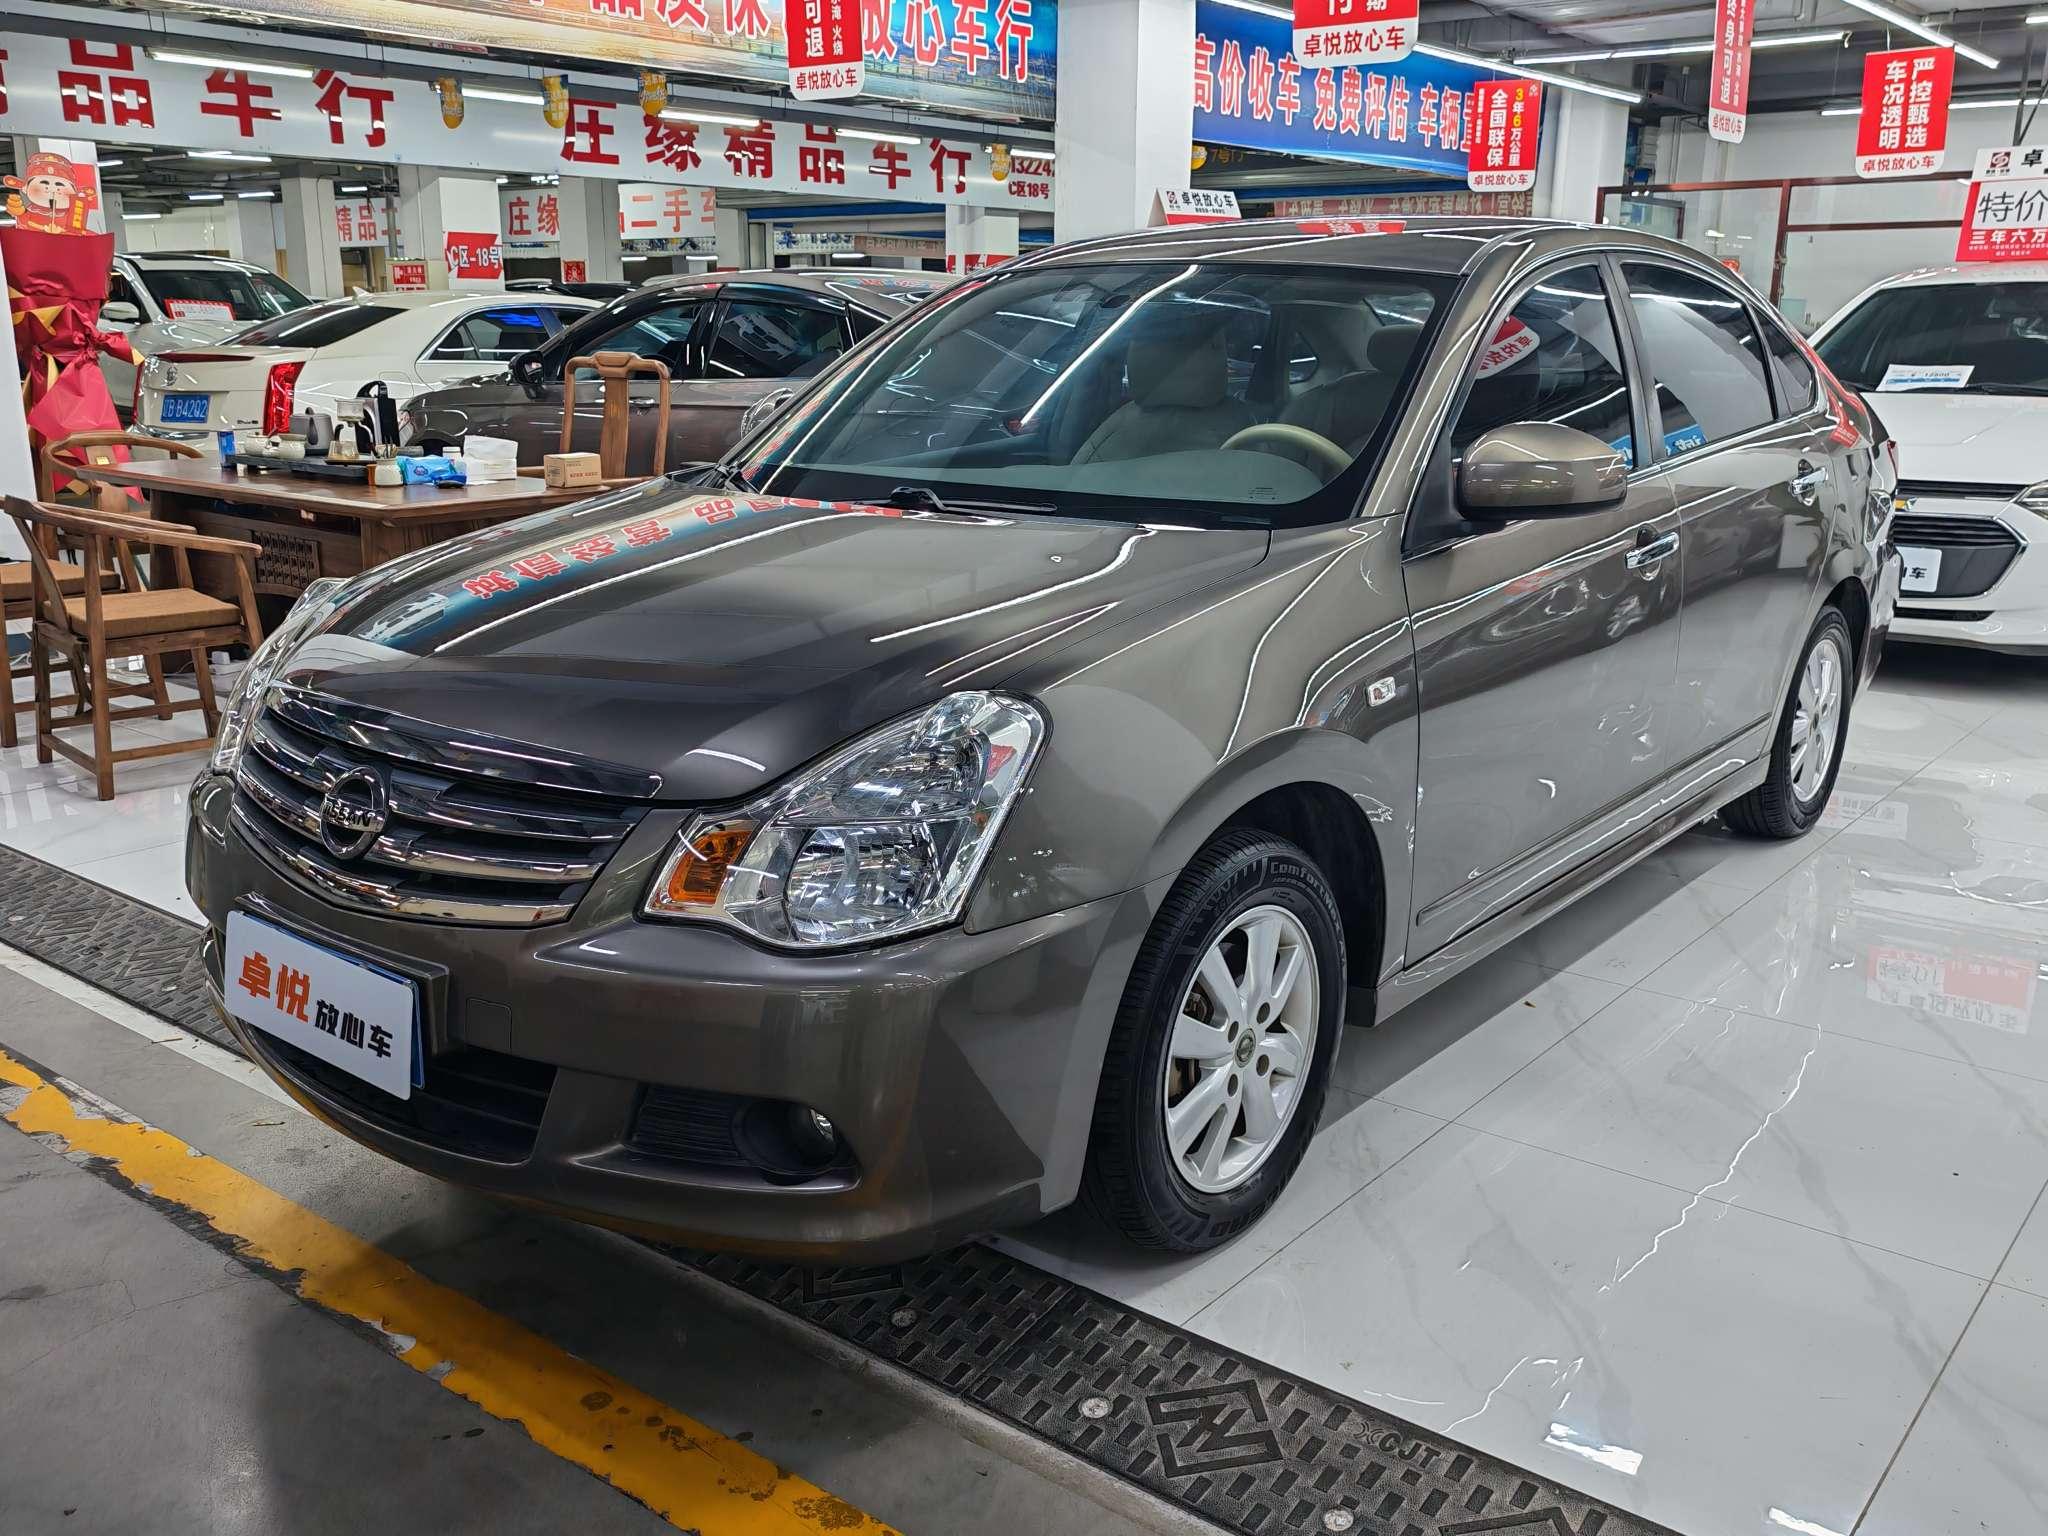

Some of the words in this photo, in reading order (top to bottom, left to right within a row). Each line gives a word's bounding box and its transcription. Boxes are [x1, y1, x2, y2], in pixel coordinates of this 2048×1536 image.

[1303, 26, 1405, 58] 卓悦放心车
[796, 68, 858, 91] 卓悦放心车
[1194, 34, 1302, 126] 高价收车
[1313, 66, 1410, 143] 免费评估
[1879, 60, 1907, 149] 车况透明
[1904, 57, 1935, 148] 严控甄选
[1487, 88, 1509, 168] 全国联保
[1508, 88, 1525, 167] 3年6万公里
[560, 97, 972, 195] 庄缘精品车行
[1473, 173, 1529, 187] 卓悦放心车
[1863, 155, 1936, 173] 卓悦放心车
[1008, 181, 1050, 199] C区18号
[1182, 191, 1235, 208] 卓悦放心车
[1978, 189, 2048, 223] 特价
[508, 195, 560, 237] 庄缘
[1970, 229, 2048, 246] 三年六万
[450, 245, 500, 270] C区-18号
